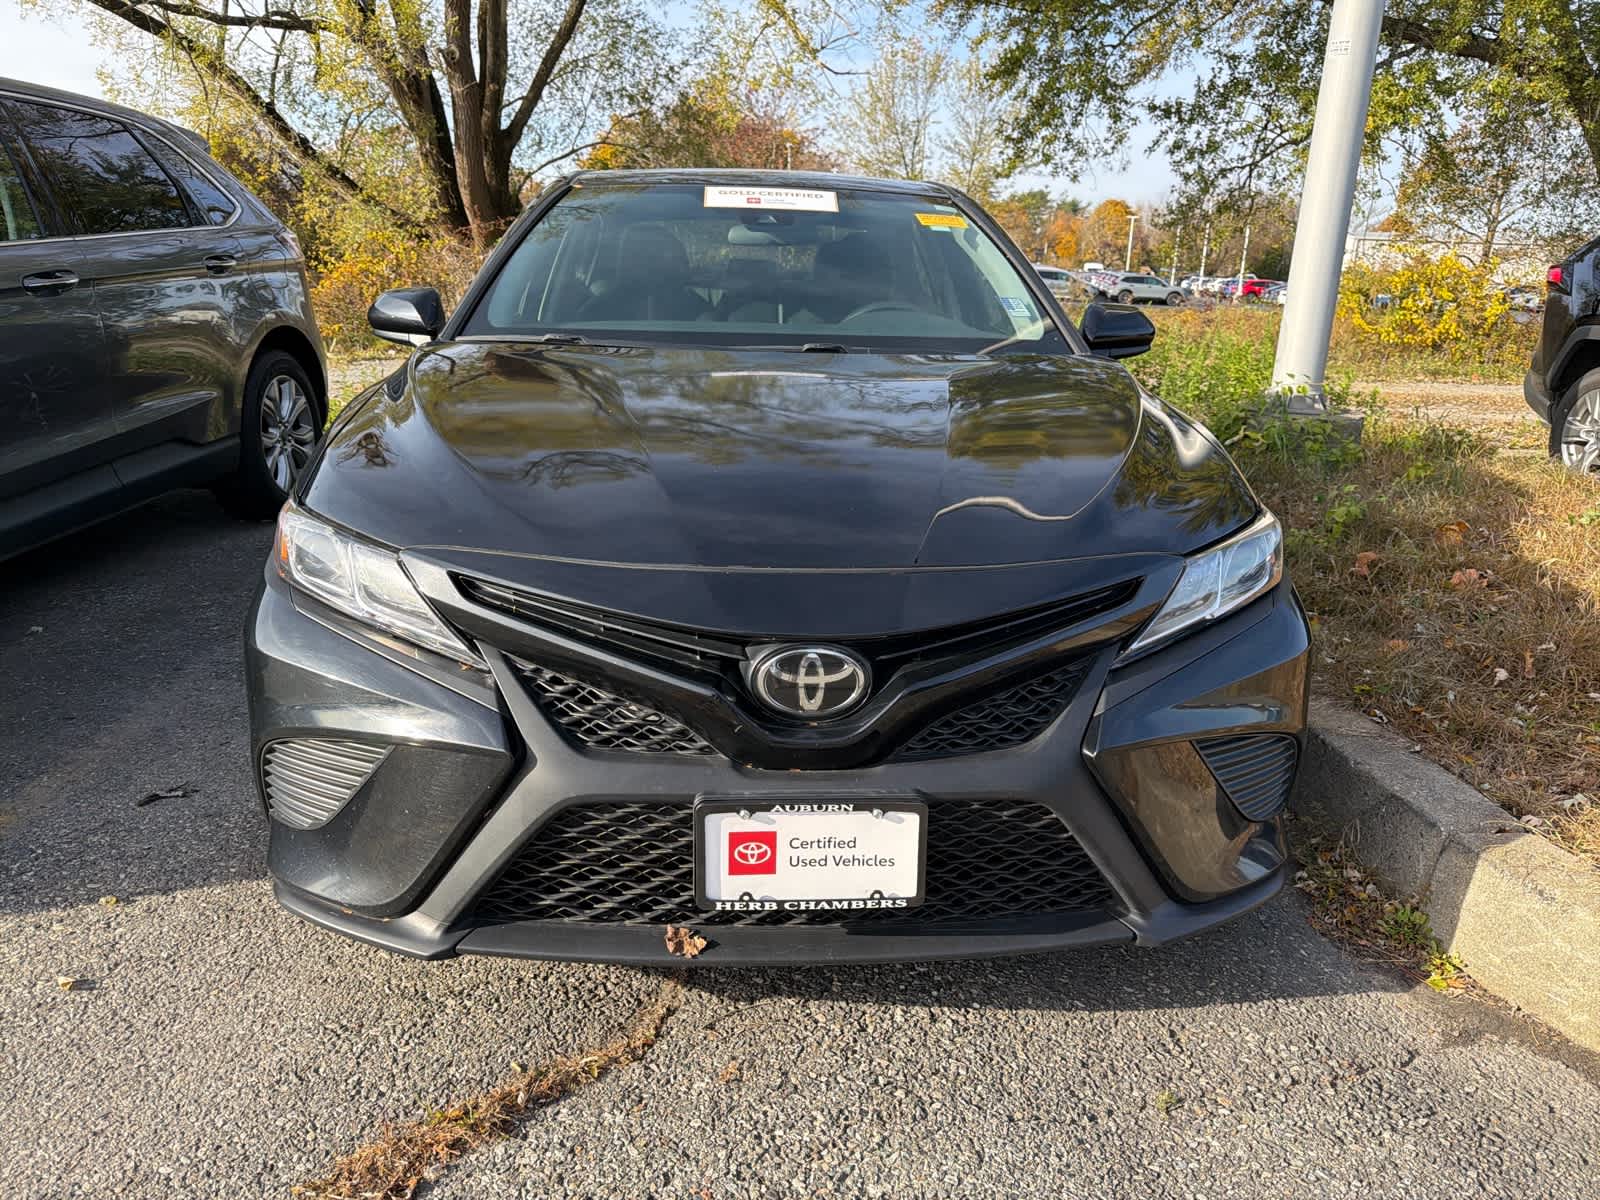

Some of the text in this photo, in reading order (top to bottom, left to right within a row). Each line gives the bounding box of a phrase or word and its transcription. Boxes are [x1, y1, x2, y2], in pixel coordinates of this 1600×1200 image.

[758, 191, 825, 199] CERTIFIED
[770, 803, 855, 813] AUBURN
[789, 837, 857, 849] Certified
[789, 854, 896, 867] Used Vehicles
[715, 899, 908, 911] HERB CHAMBERS
